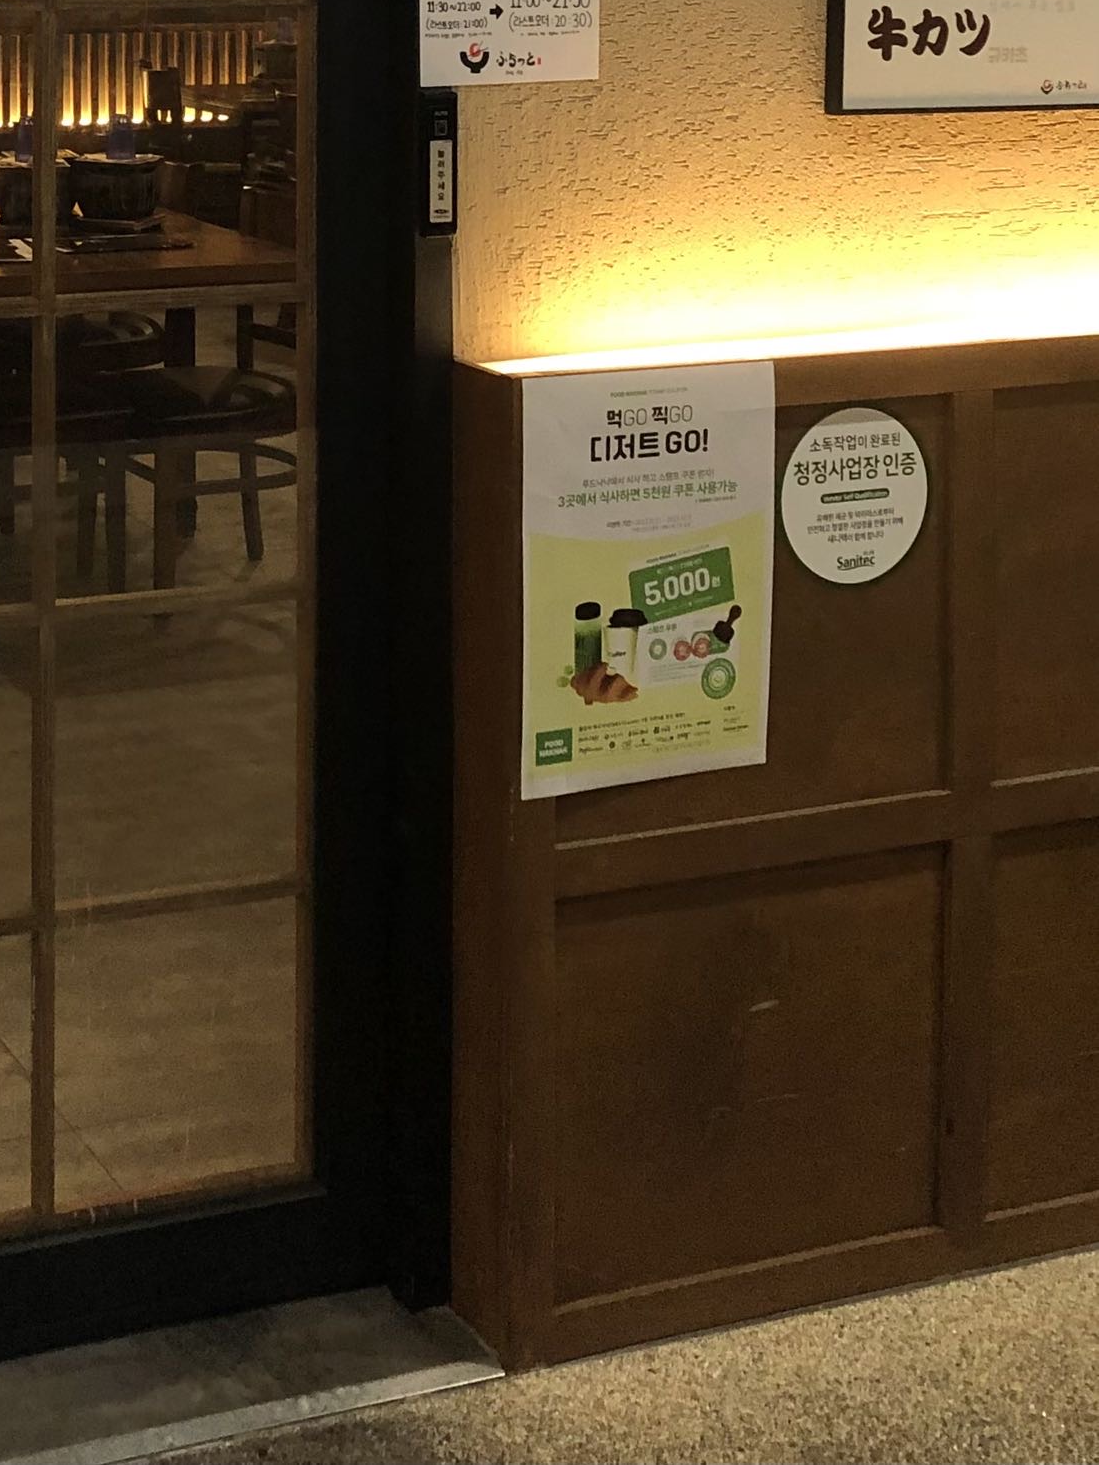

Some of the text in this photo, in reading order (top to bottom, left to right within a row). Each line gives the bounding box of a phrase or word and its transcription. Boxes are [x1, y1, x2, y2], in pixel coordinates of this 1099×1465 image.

[867, 5, 991, 62] 牛カツ
[607, 404, 693, 429] 먹GO 찍GO
[590, 428, 709, 462] 디저트 GO!
[809, 432, 901, 453] 소독작업이 완료된
[793, 452, 917, 486] 청정사업장 인증
[558, 479, 738, 508] 3곳에서 식사하면 5천원 쿠폰 사용가능
[837, 555, 876, 570] Sanitec
